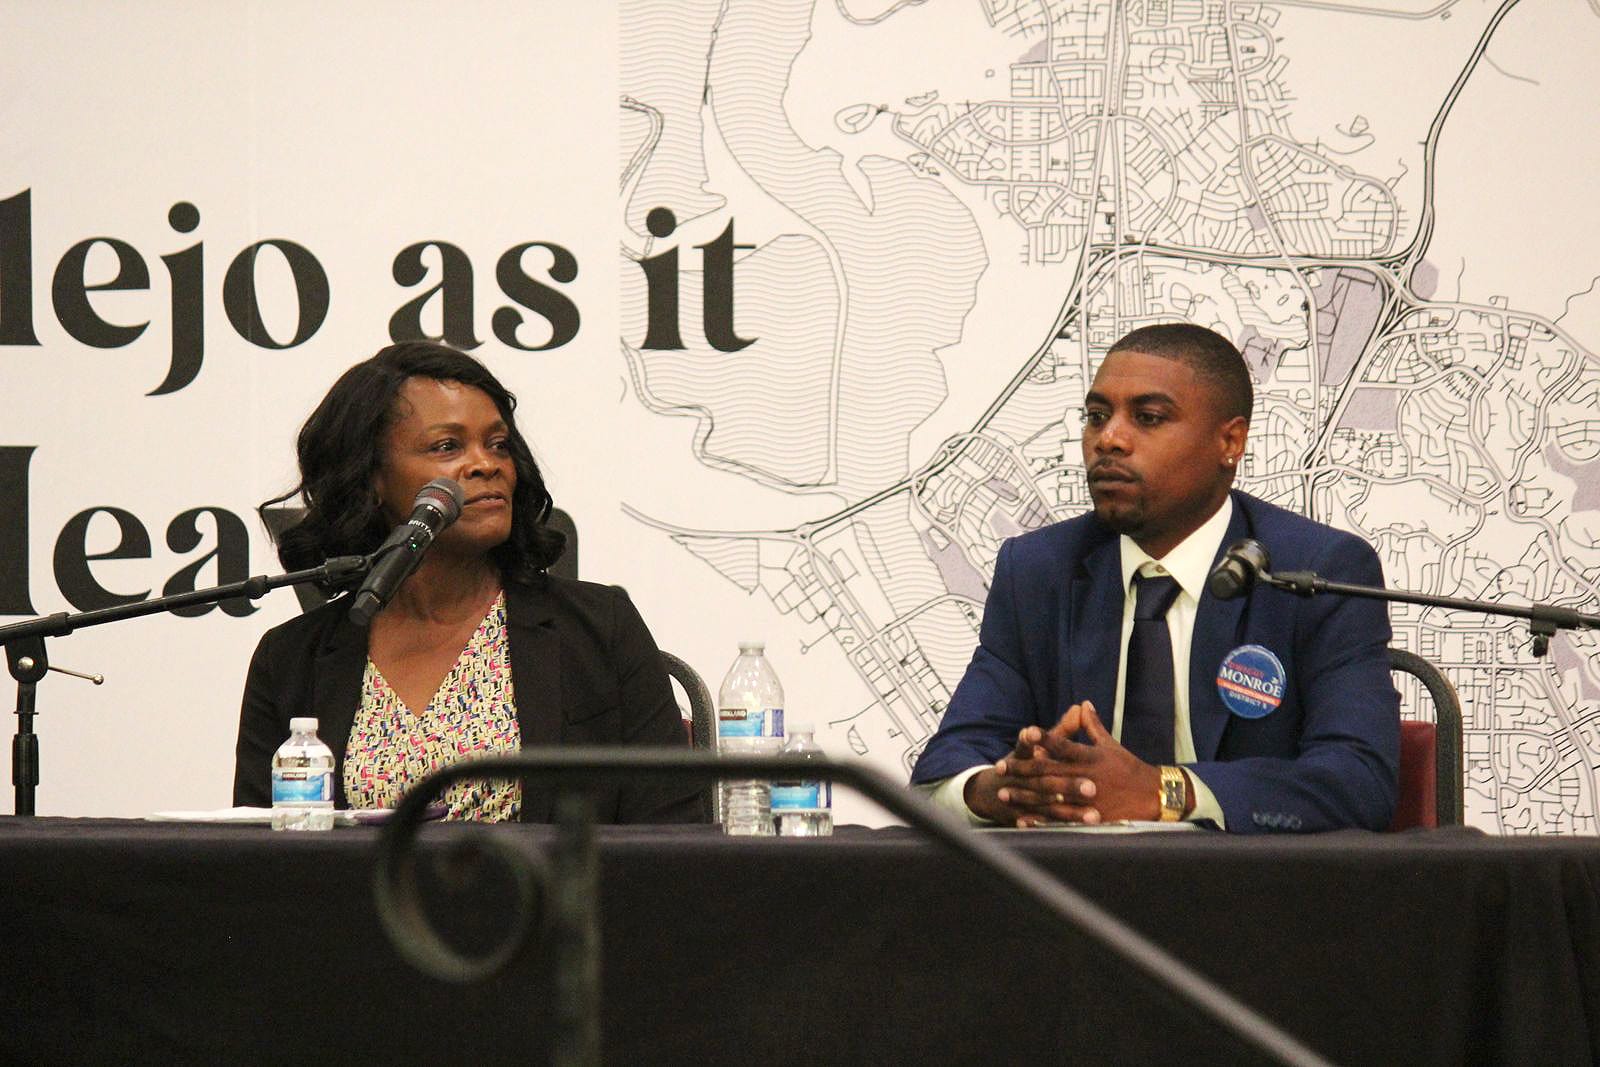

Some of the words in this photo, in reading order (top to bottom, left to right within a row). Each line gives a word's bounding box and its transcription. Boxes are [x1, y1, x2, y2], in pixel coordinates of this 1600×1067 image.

[0, 188, 330, 397] lejo
[388, 241, 580, 352] as
[640, 207, 756, 352] it
[1219, 666, 1282, 698] MONROE
